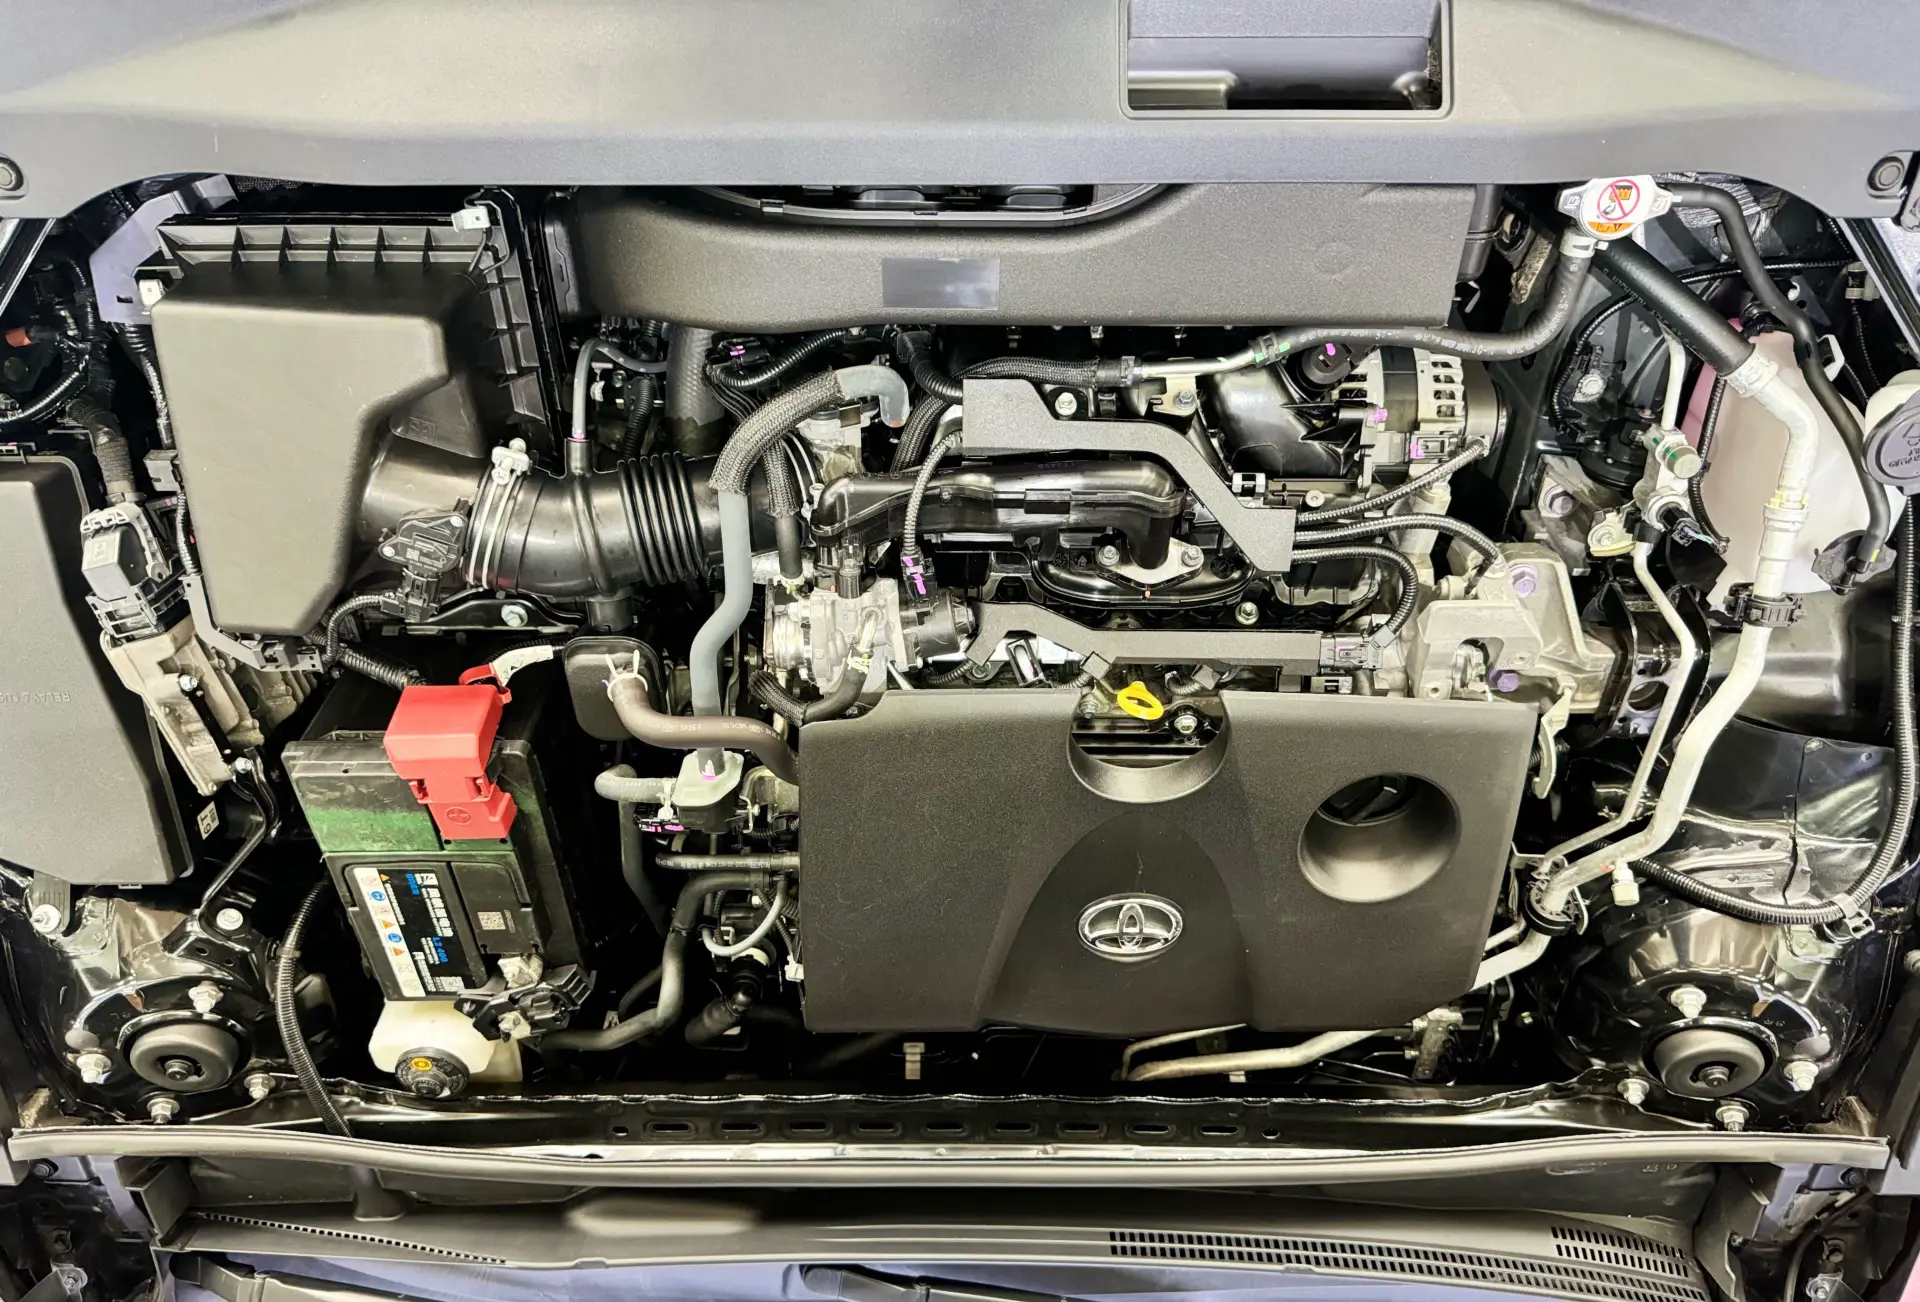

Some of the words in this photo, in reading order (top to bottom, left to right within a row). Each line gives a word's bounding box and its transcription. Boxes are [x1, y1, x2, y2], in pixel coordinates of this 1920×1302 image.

[32, 692, 71, 703] RELAY
[431, 936, 443, 947] L2
[436, 947, 448, 963] 400
